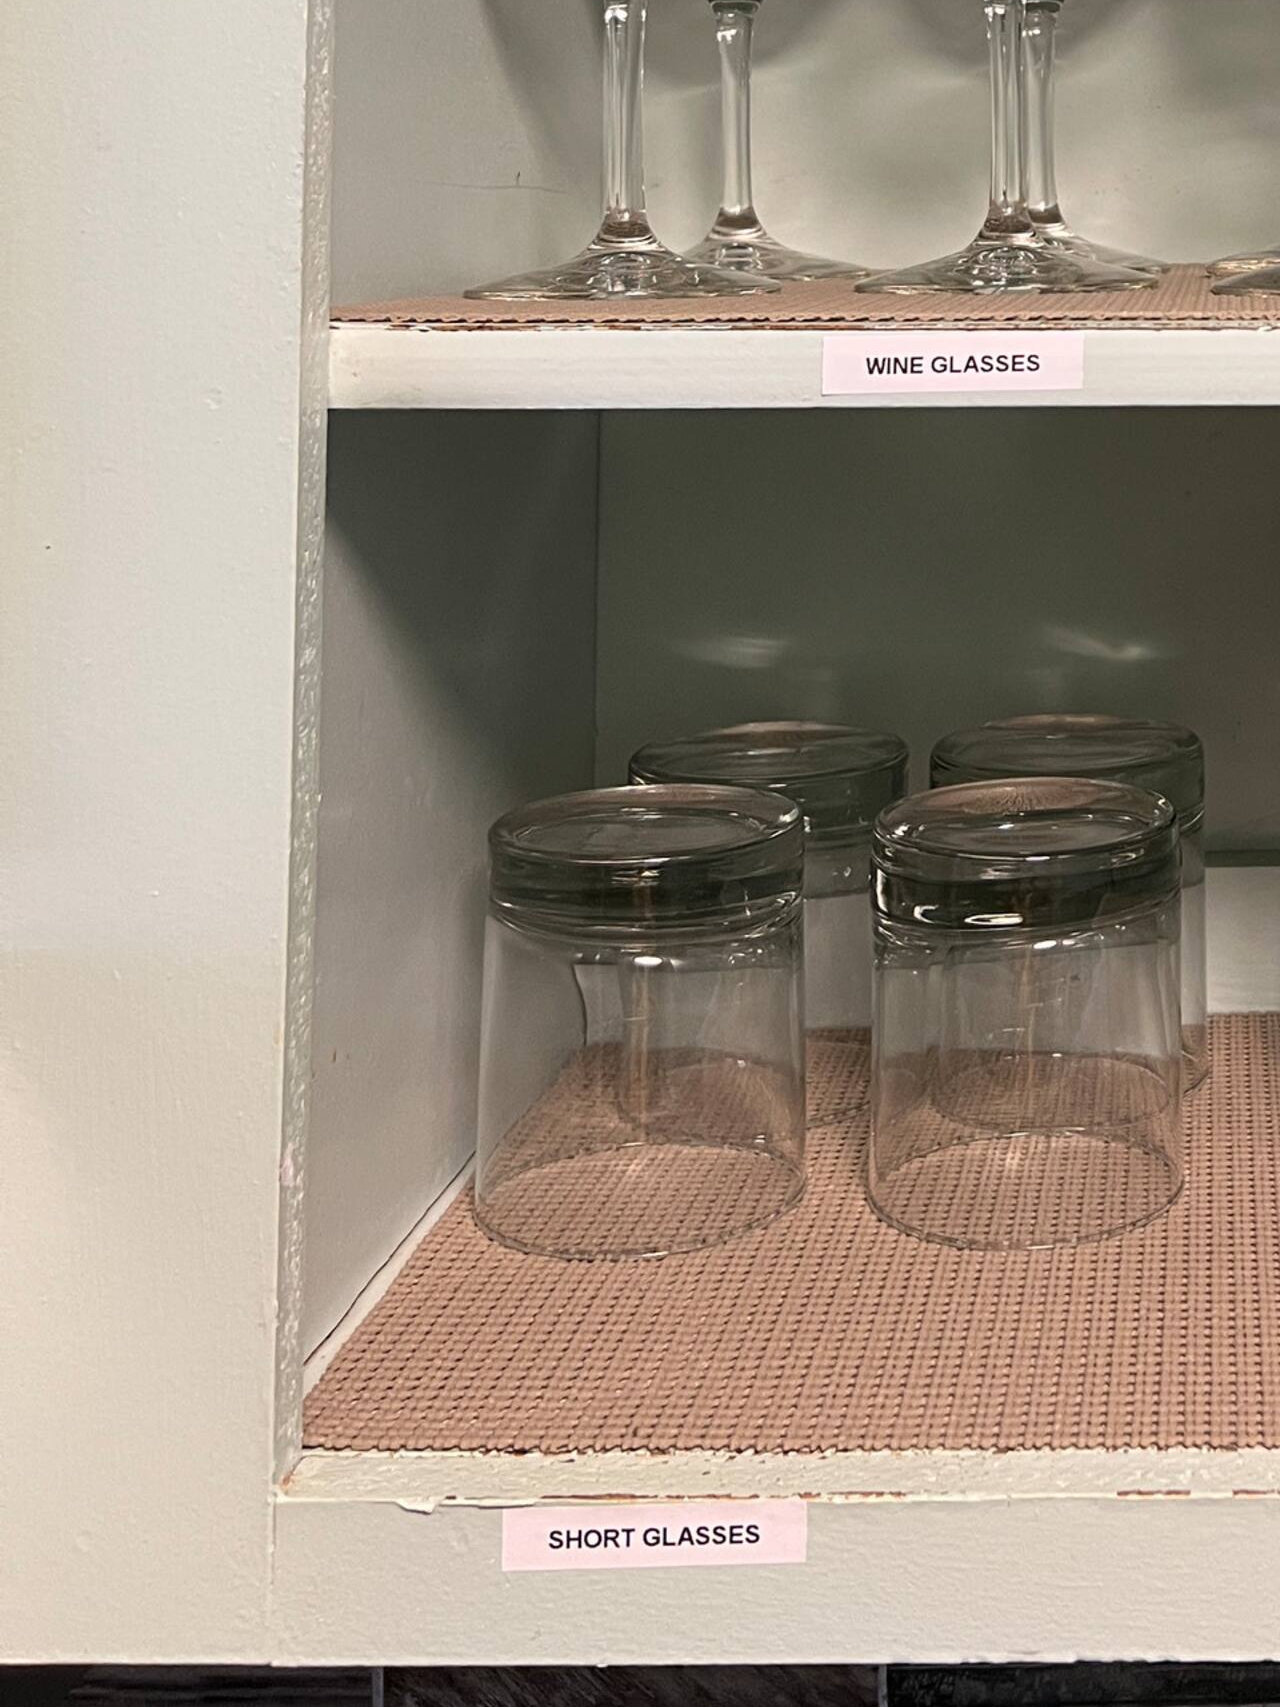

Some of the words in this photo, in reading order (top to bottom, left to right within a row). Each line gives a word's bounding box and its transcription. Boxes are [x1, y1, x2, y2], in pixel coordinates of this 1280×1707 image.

[866, 356, 924, 375] WINE
[931, 354, 1040, 374] GLASSES
[548, 1528, 636, 1550] SHORT
[642, 1524, 760, 1547] GLASSES
